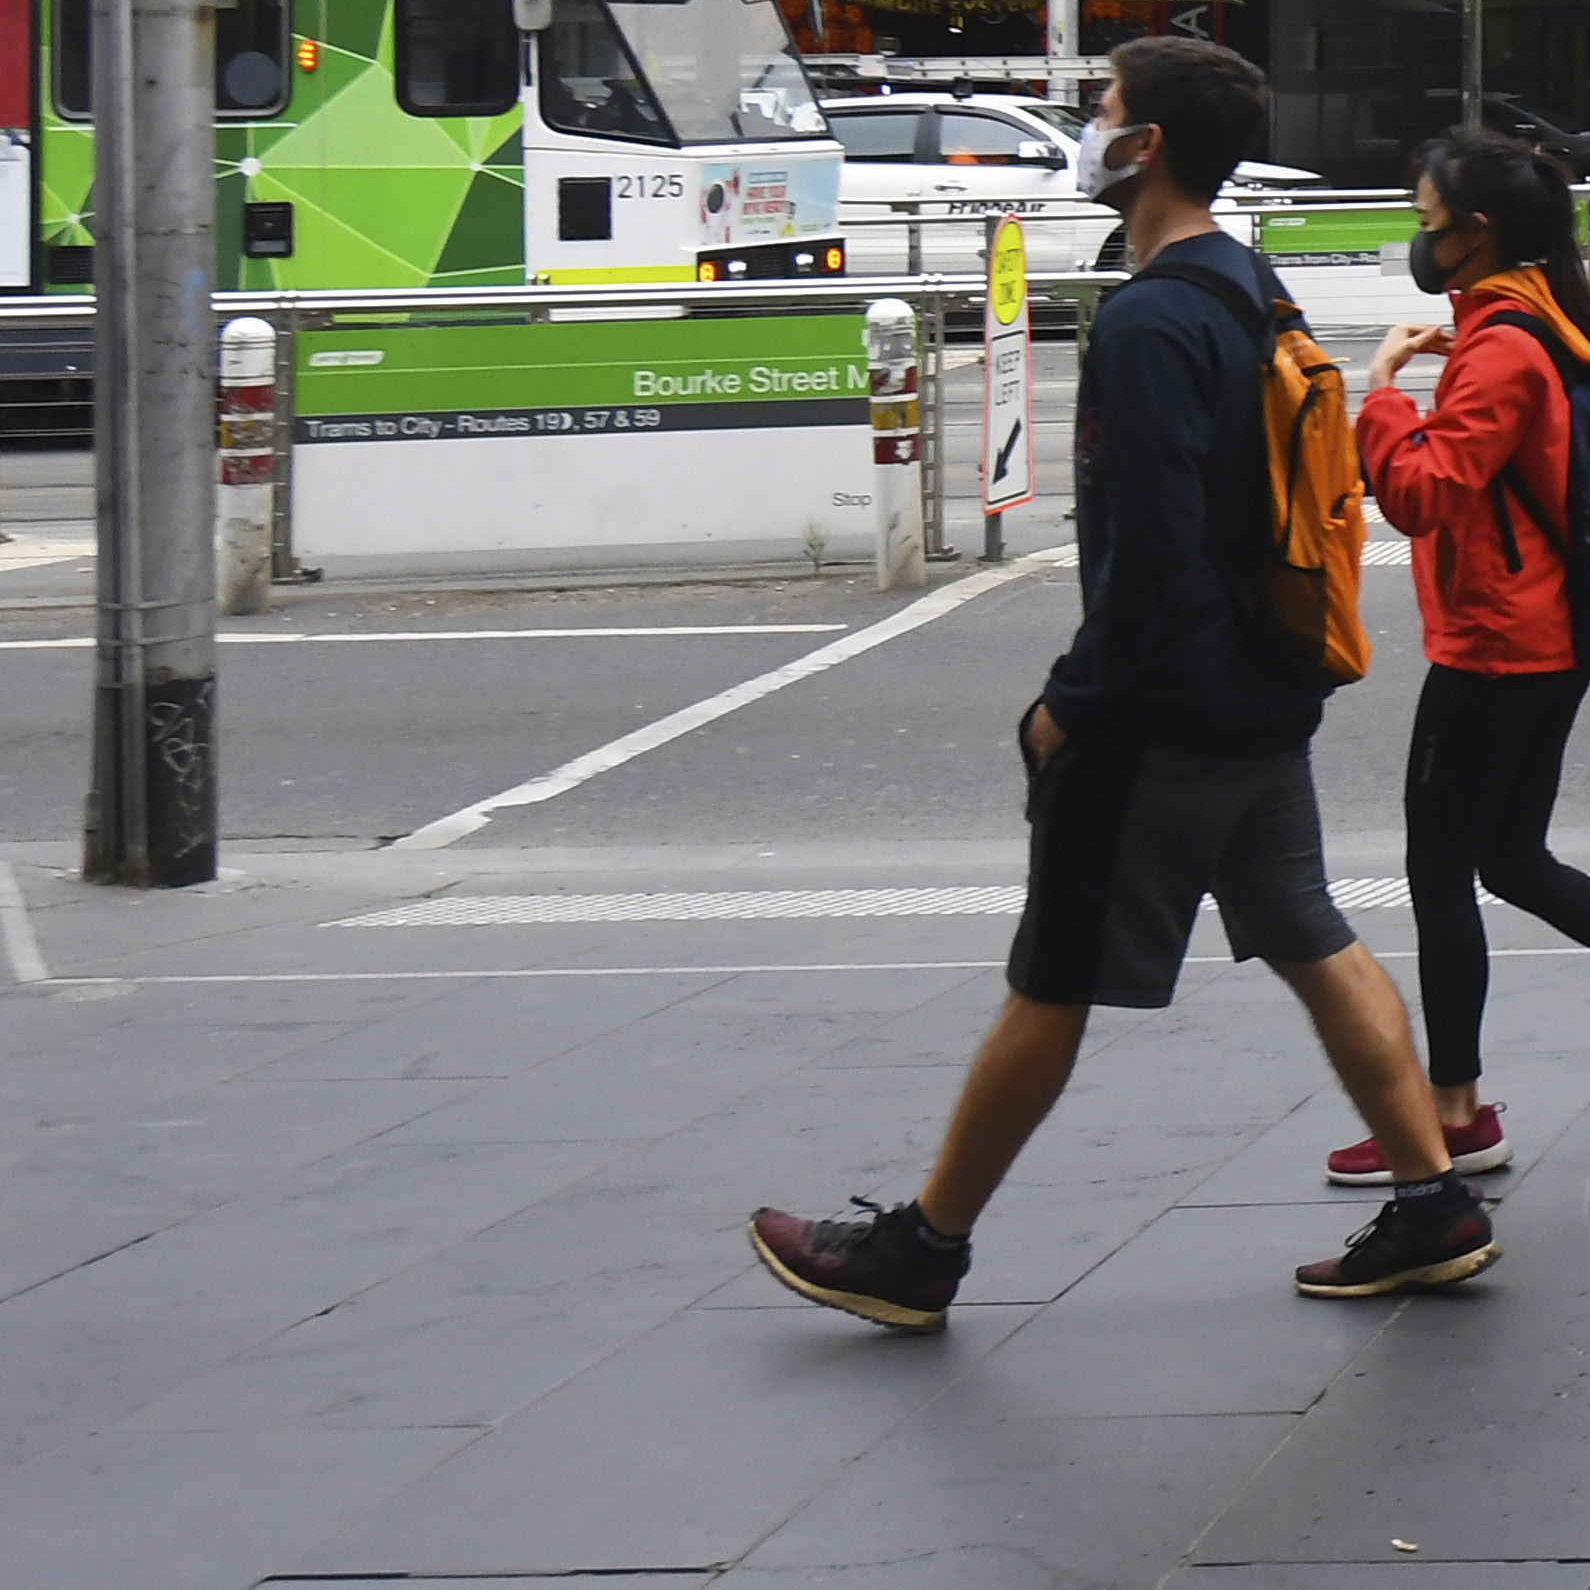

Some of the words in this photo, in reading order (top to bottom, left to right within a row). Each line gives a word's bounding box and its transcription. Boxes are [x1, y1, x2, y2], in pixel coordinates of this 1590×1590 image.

[617, 174, 684, 199] 2125
[1329, 253, 1353, 267] City
[633, 367, 742, 398] Bourke
[748, 365, 840, 394] Street
[304, 419, 372, 438] Trams
[374, 418, 397, 436] to
[400, 415, 443, 440] City
[460, 413, 530, 434] Routes
[584, 410, 609, 428] 57
[614, 410, 630, 428] &
[633, 408, 661, 427] 59
